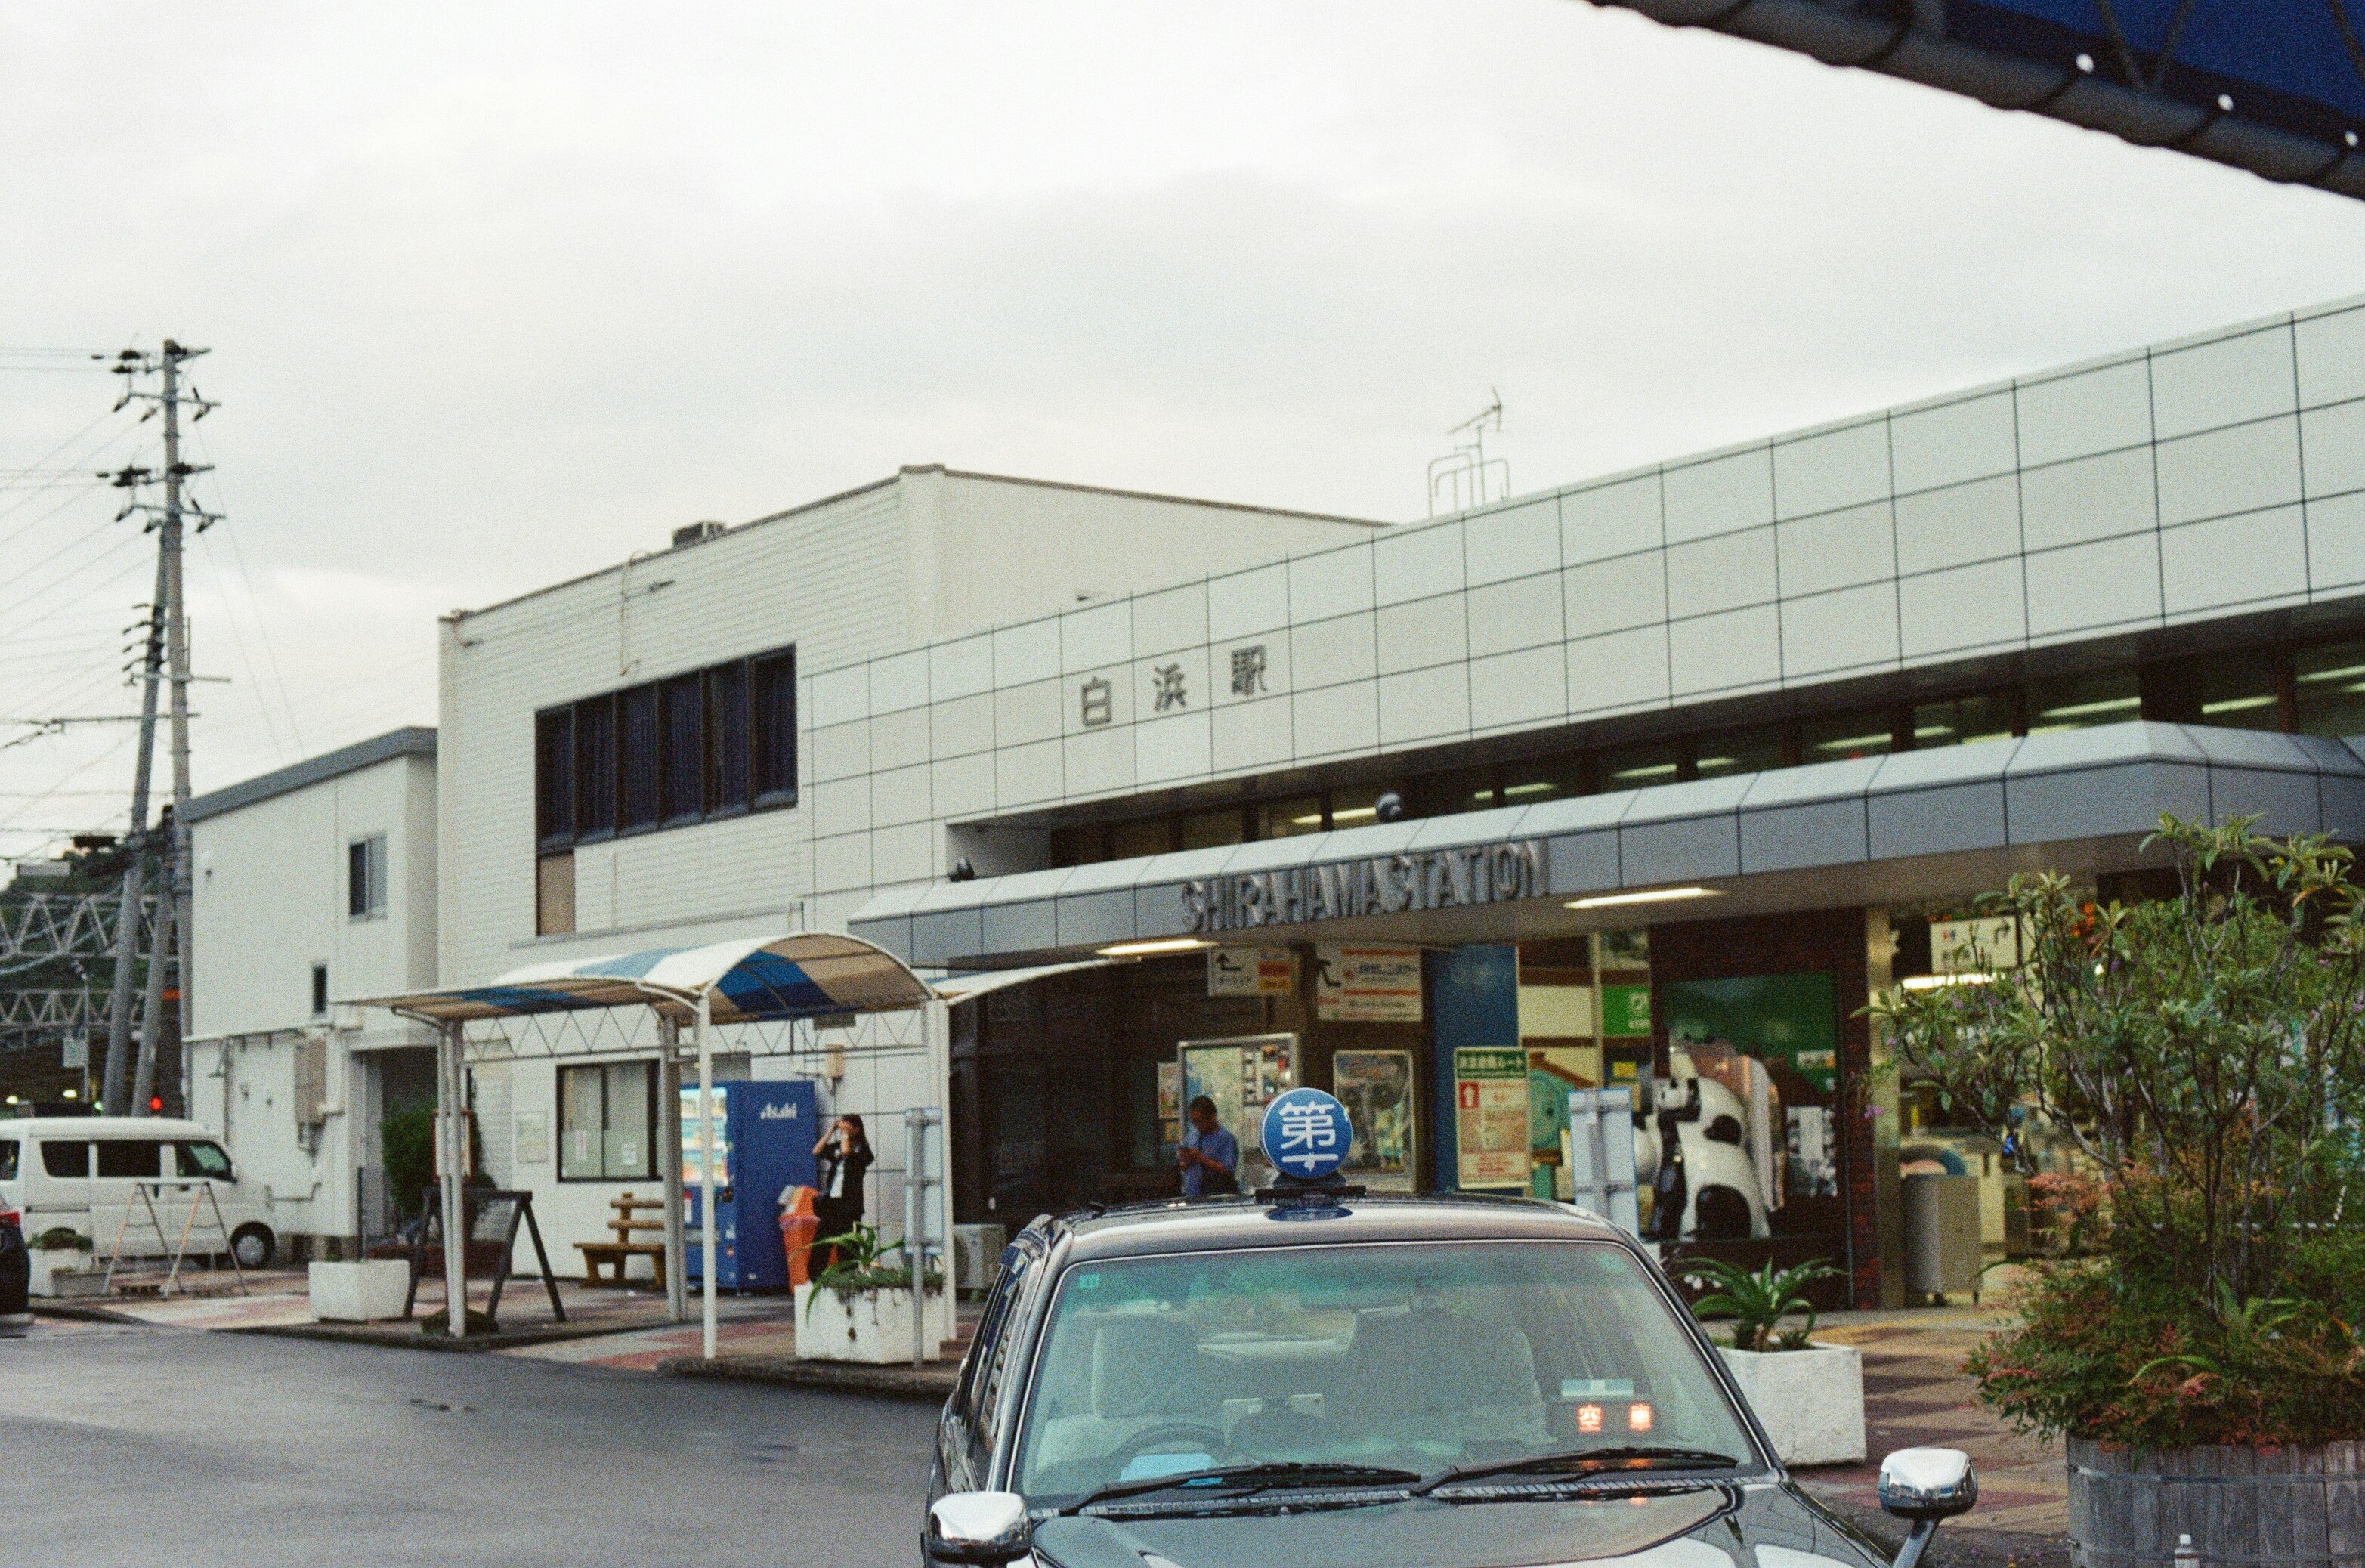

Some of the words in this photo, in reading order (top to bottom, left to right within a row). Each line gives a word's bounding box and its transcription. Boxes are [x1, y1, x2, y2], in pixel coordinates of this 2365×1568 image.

[1081, 645, 1268, 727] 白浜駅
[1182, 859, 1389, 934] SHIRAHAMA
[1389, 837, 1548, 911] STATION
